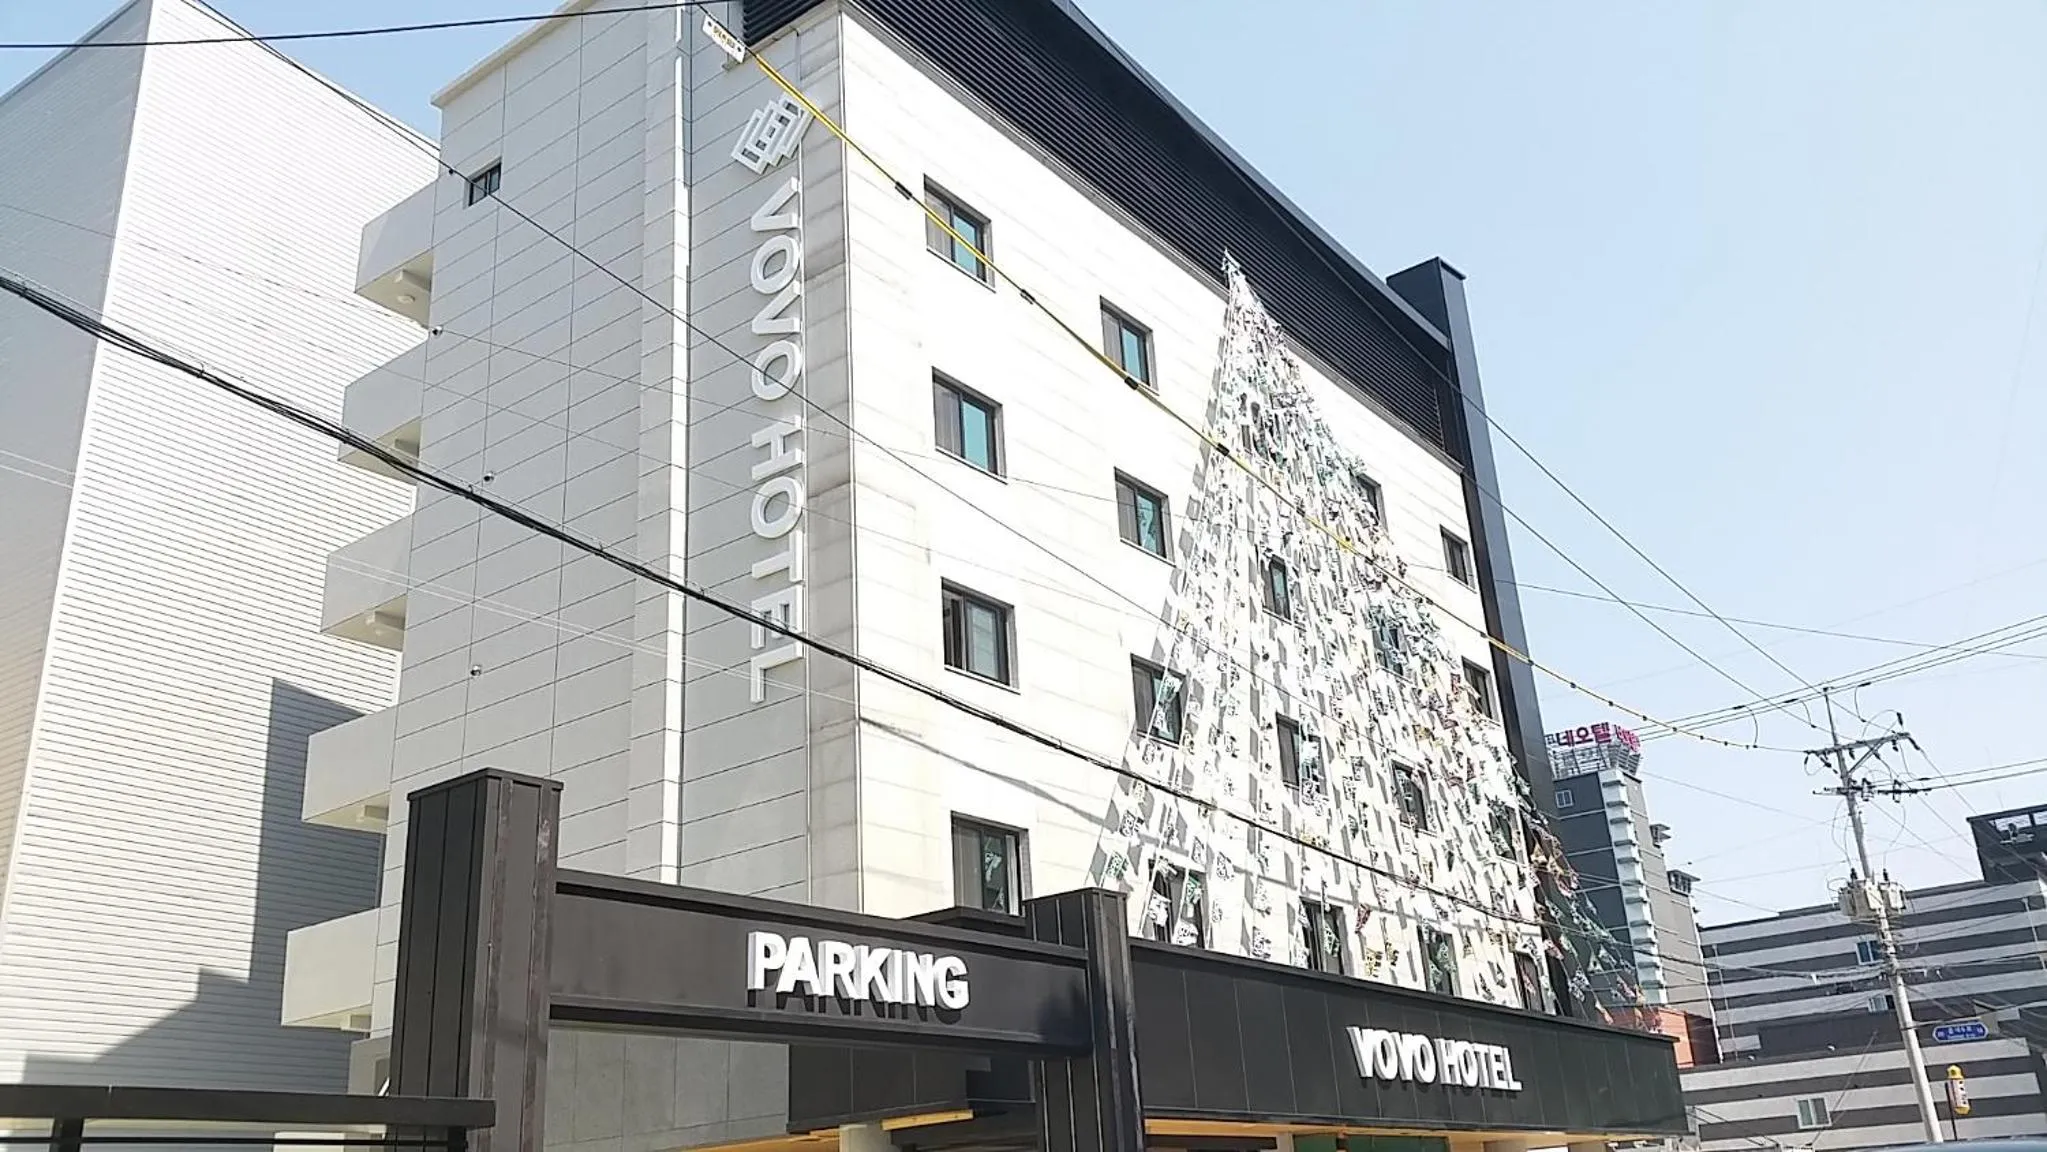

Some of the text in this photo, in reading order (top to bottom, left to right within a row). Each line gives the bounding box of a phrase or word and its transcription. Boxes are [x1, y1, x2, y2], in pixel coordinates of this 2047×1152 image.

[751, 176, 804, 703] VOVO HOTEL
[1555, 722, 1612, 747] 네오텔
[747, 931, 970, 1010] PARKING
[1345, 1026, 1523, 1091] VOVO HOTEL
